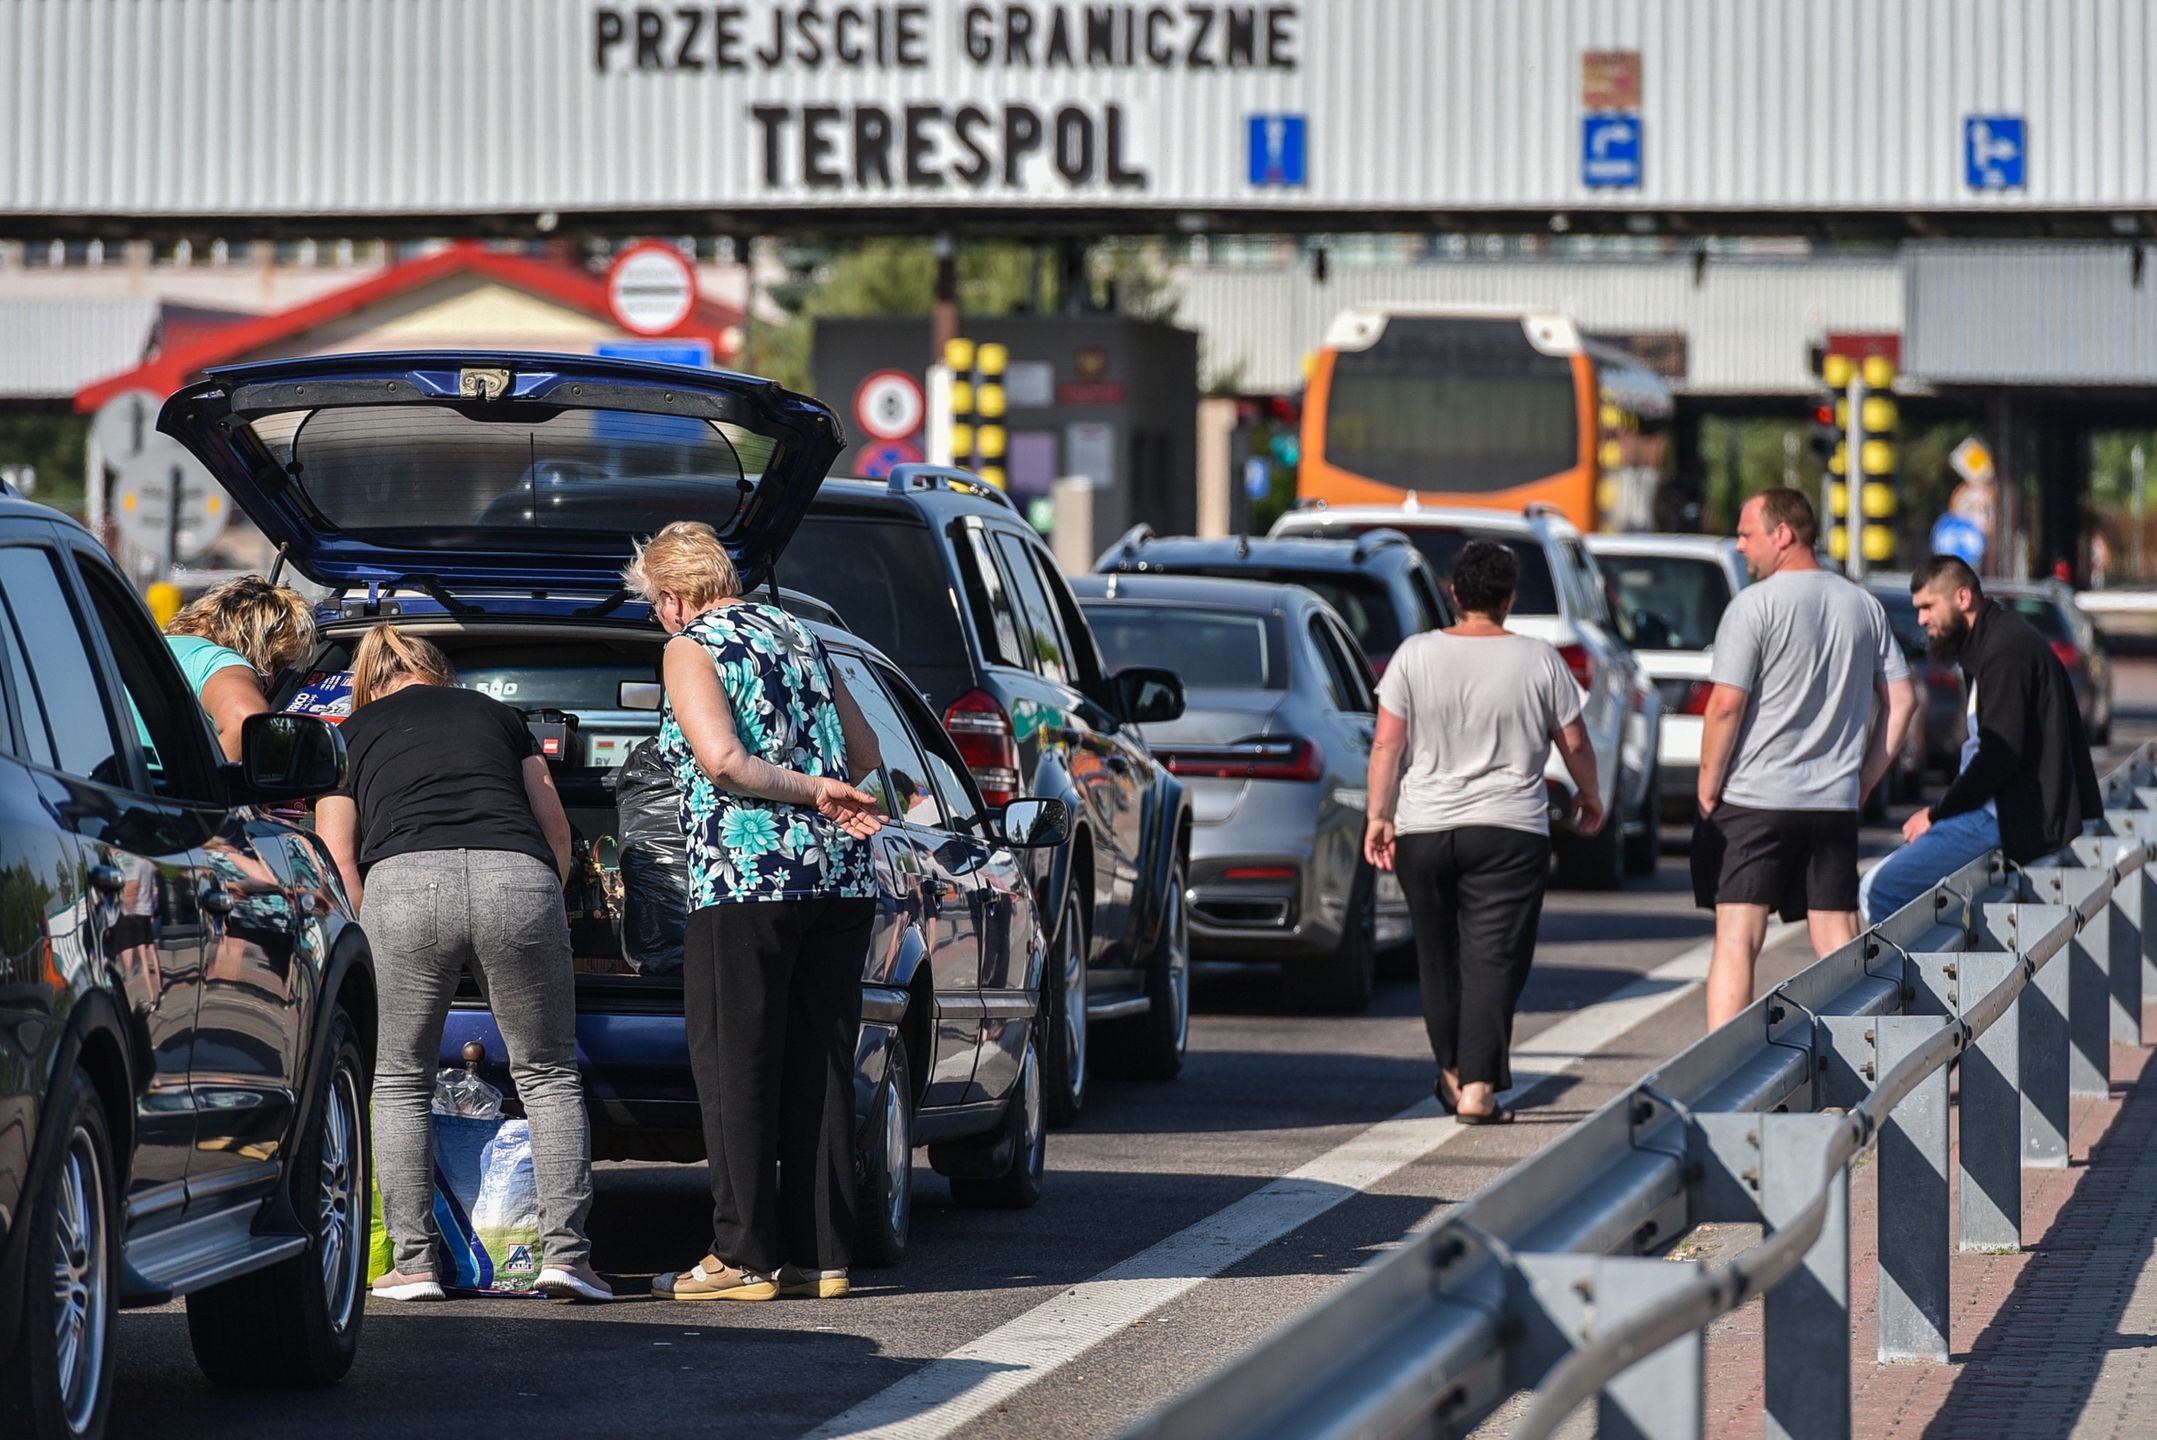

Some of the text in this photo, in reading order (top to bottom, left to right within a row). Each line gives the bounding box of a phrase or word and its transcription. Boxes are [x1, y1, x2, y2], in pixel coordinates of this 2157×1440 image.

[594, 0, 1297, 72] PRZEJŚCIE GRANICZNE
[750, 102, 1147, 189] TERESPOL
